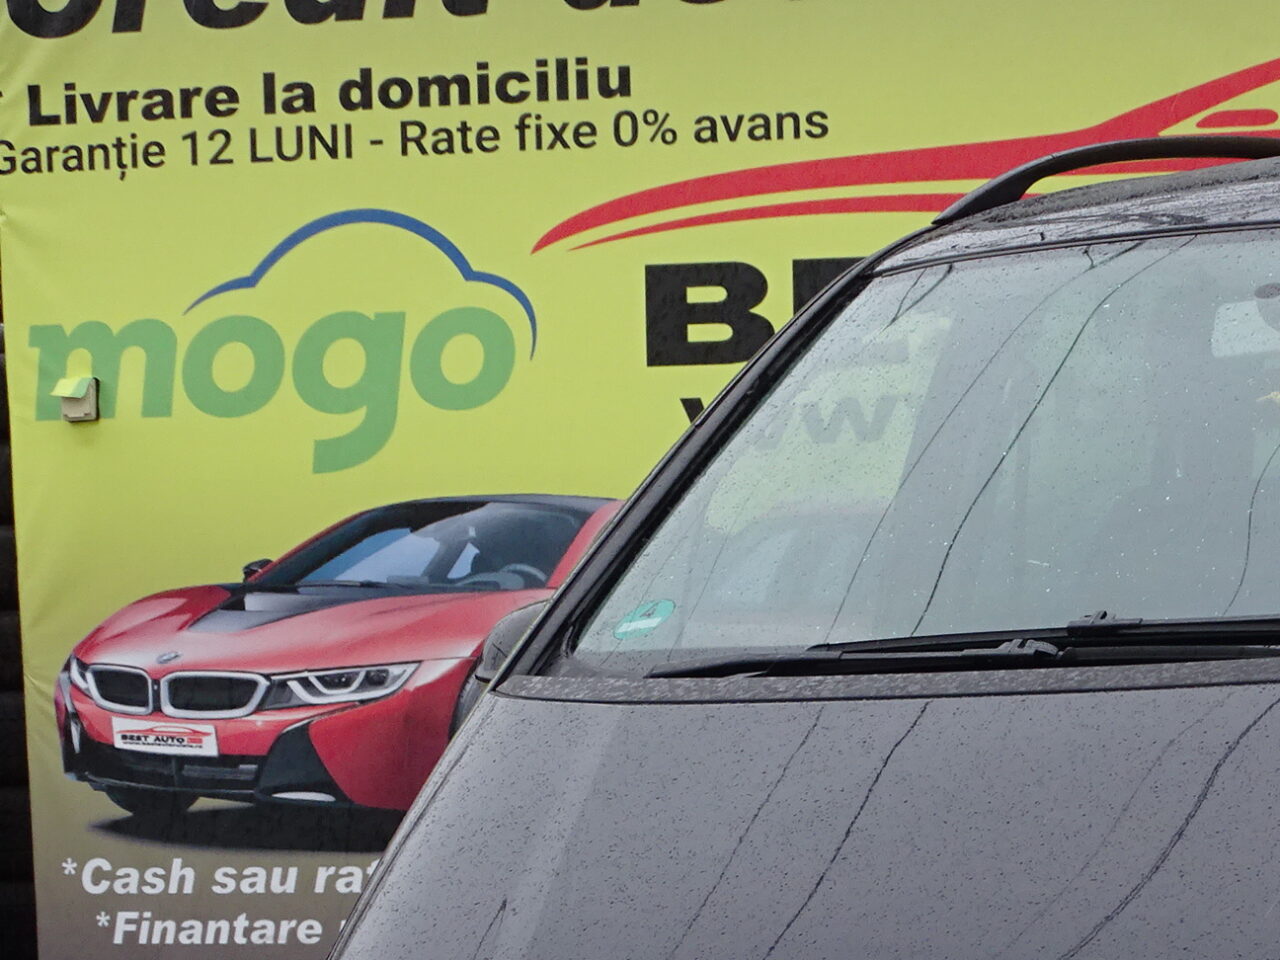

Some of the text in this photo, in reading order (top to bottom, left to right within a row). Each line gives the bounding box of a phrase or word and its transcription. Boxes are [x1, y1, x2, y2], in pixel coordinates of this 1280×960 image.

[27, 56, 632, 126] Livrare la domiciliu
[181, 128, 234, 166] 12
[250, 123, 353, 163] LUNI
[400, 119, 500, 156] Rate
[514, 112, 597, 151] fixe
[613, 108, 678, 147] 0%
[693, 110, 829, 144] avans
[29, 306, 517, 475] mogo
[211, 866, 298, 895] sau
